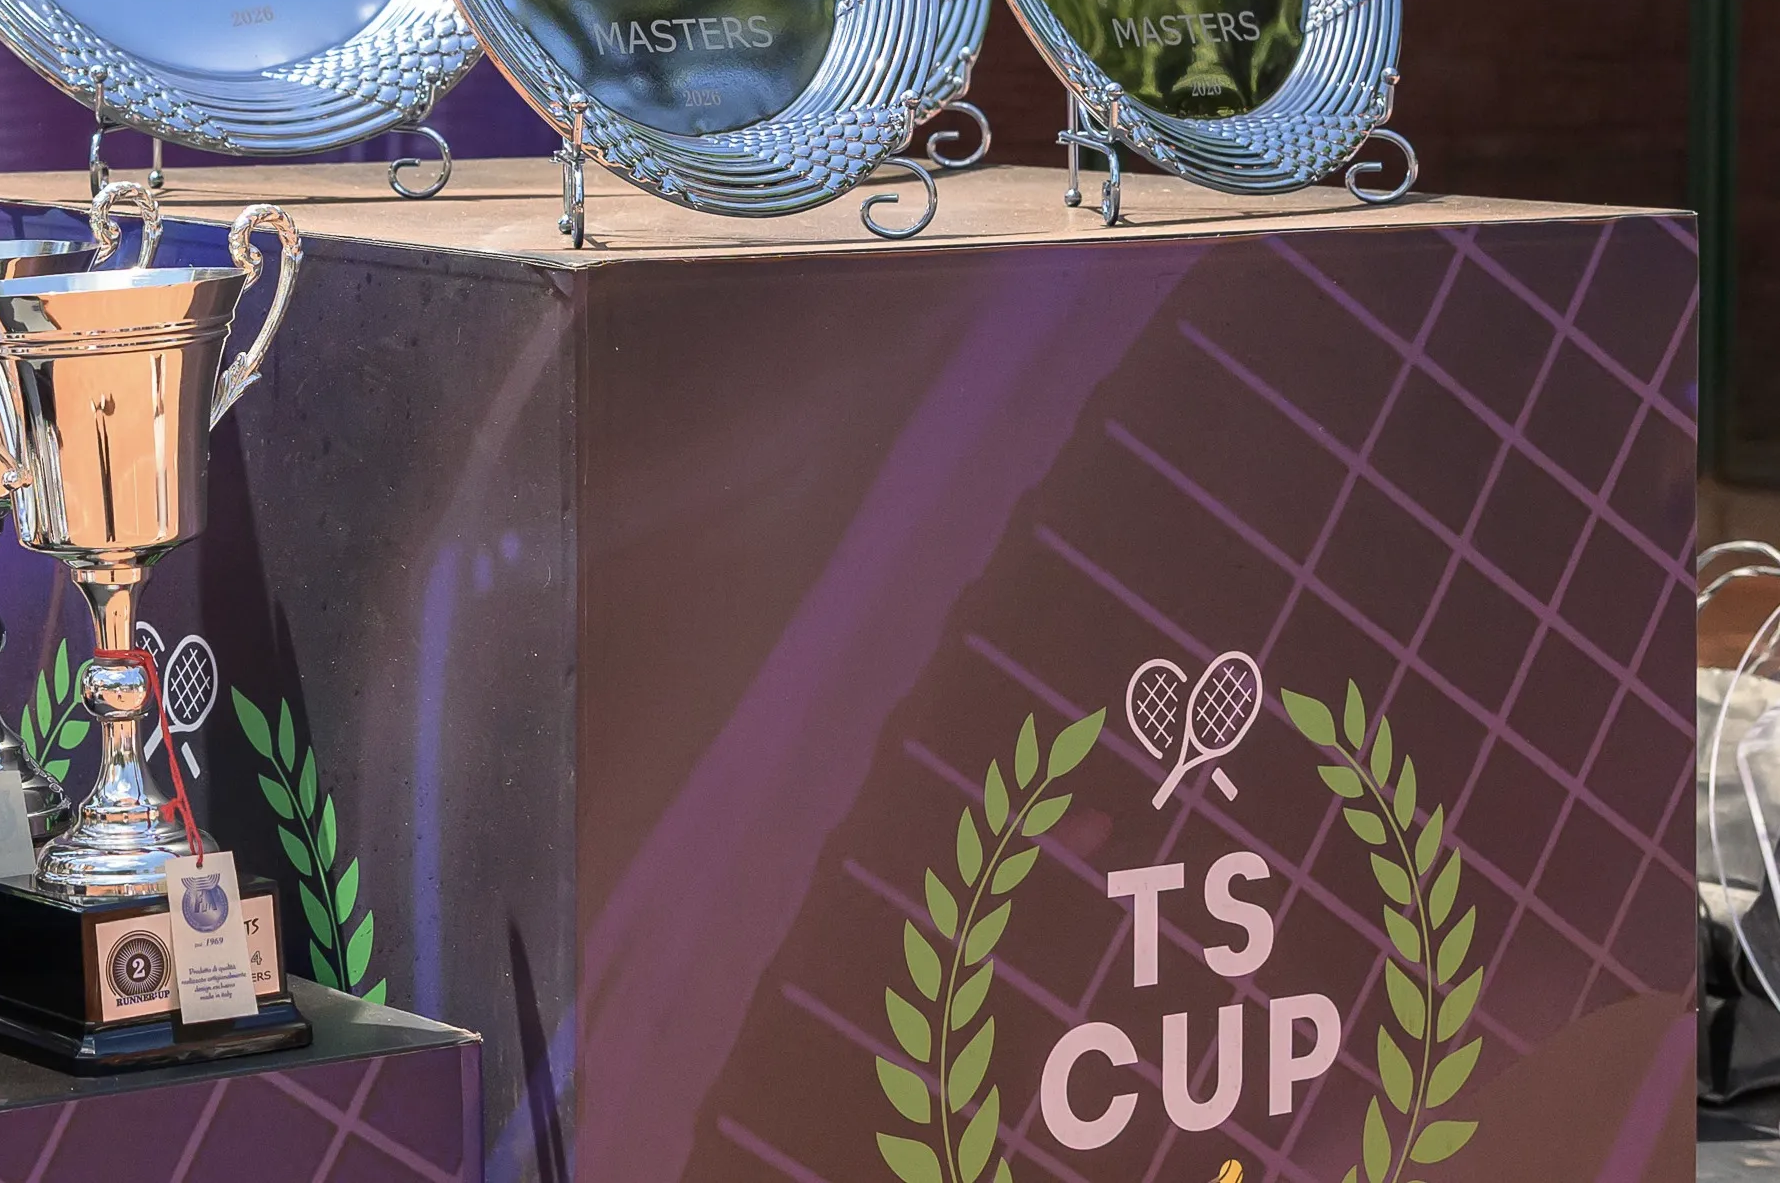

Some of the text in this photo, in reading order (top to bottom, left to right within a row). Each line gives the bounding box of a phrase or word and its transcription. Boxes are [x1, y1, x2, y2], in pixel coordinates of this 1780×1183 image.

[231, 4, 275, 27] 2026
[592, 15, 773, 55] MASTERS
[1111, 11, 1261, 48] MASTERS
[682, 89, 722, 107] 2026
[244, 918, 260, 936] TS
[1106, 849, 1278, 990] TS
[206, 937, 224, 947] 1969
[132, 957, 146, 979] 2
[251, 950, 263, 966] 4
[116, 990, 170, 1007] RUNNER-UP
[1039, 992, 1343, 1152] CUP
